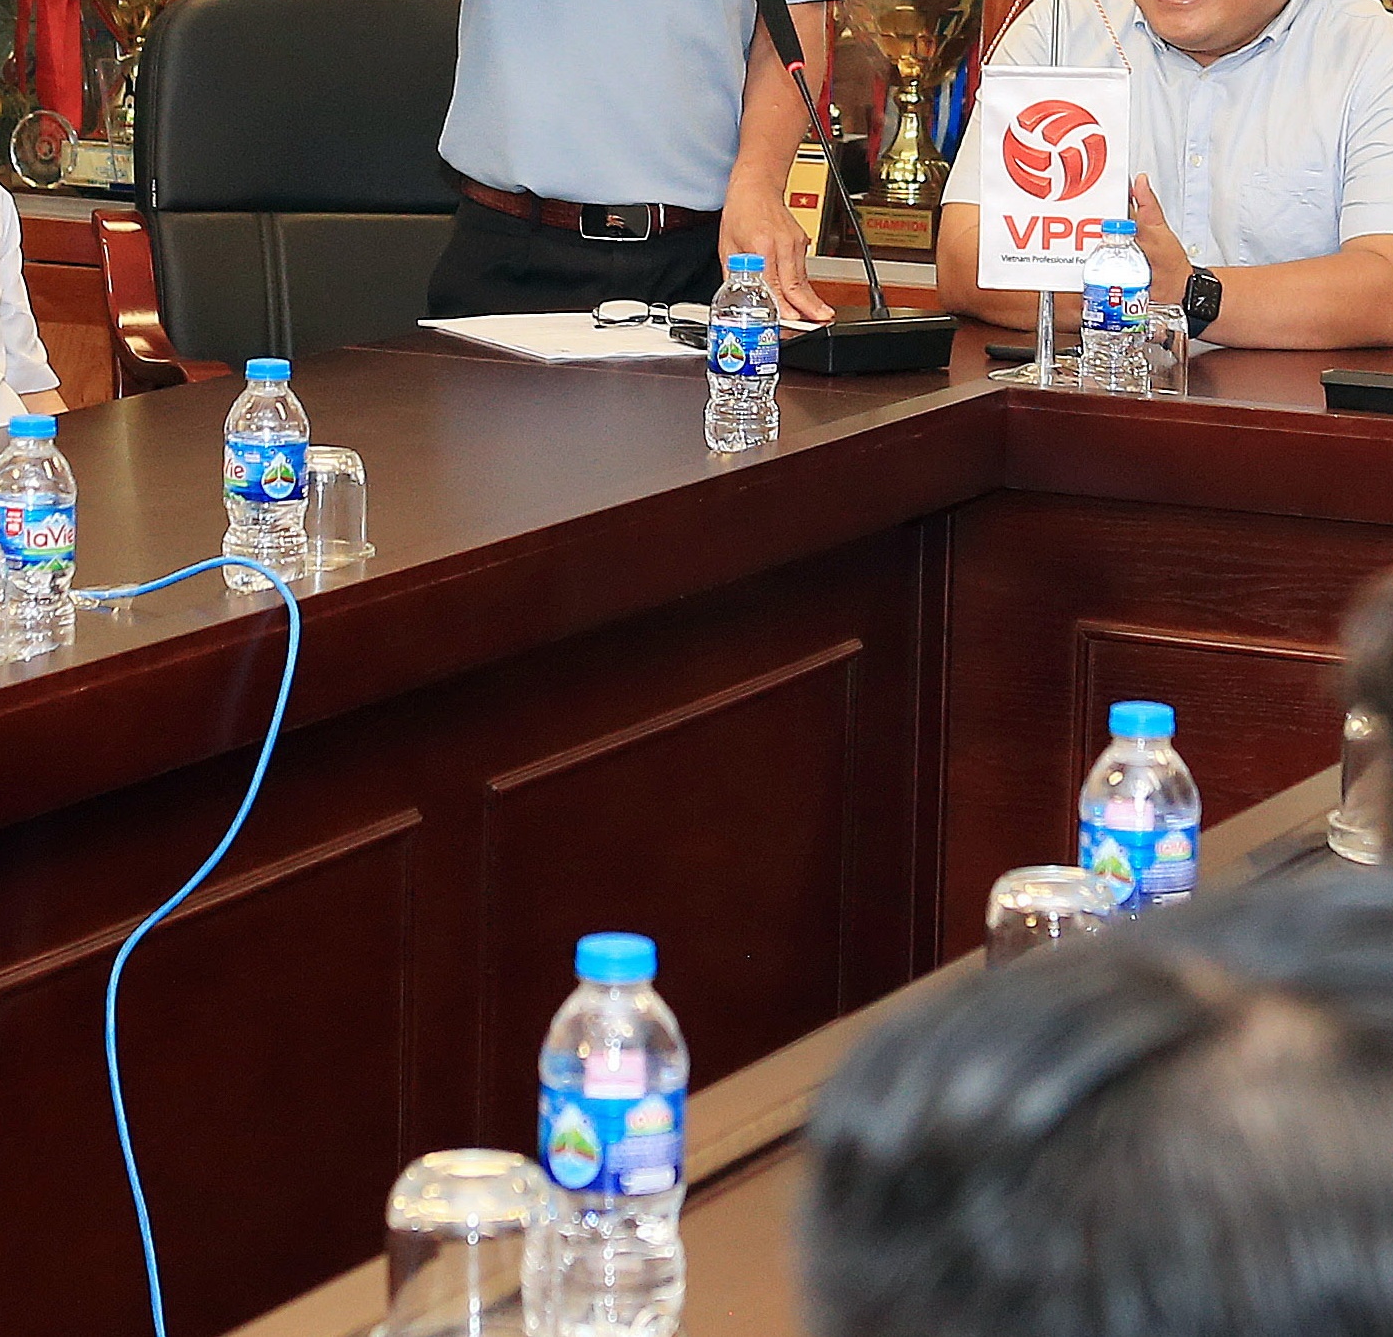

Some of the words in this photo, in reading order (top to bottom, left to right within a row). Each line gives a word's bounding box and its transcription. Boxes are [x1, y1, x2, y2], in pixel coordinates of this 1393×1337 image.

[866, 218, 928, 232] CHAMPION
[1003, 215, 1104, 251] VPF
[1001, 254, 1031, 263] Vietnam
[27, 524, 74, 548] laVie
